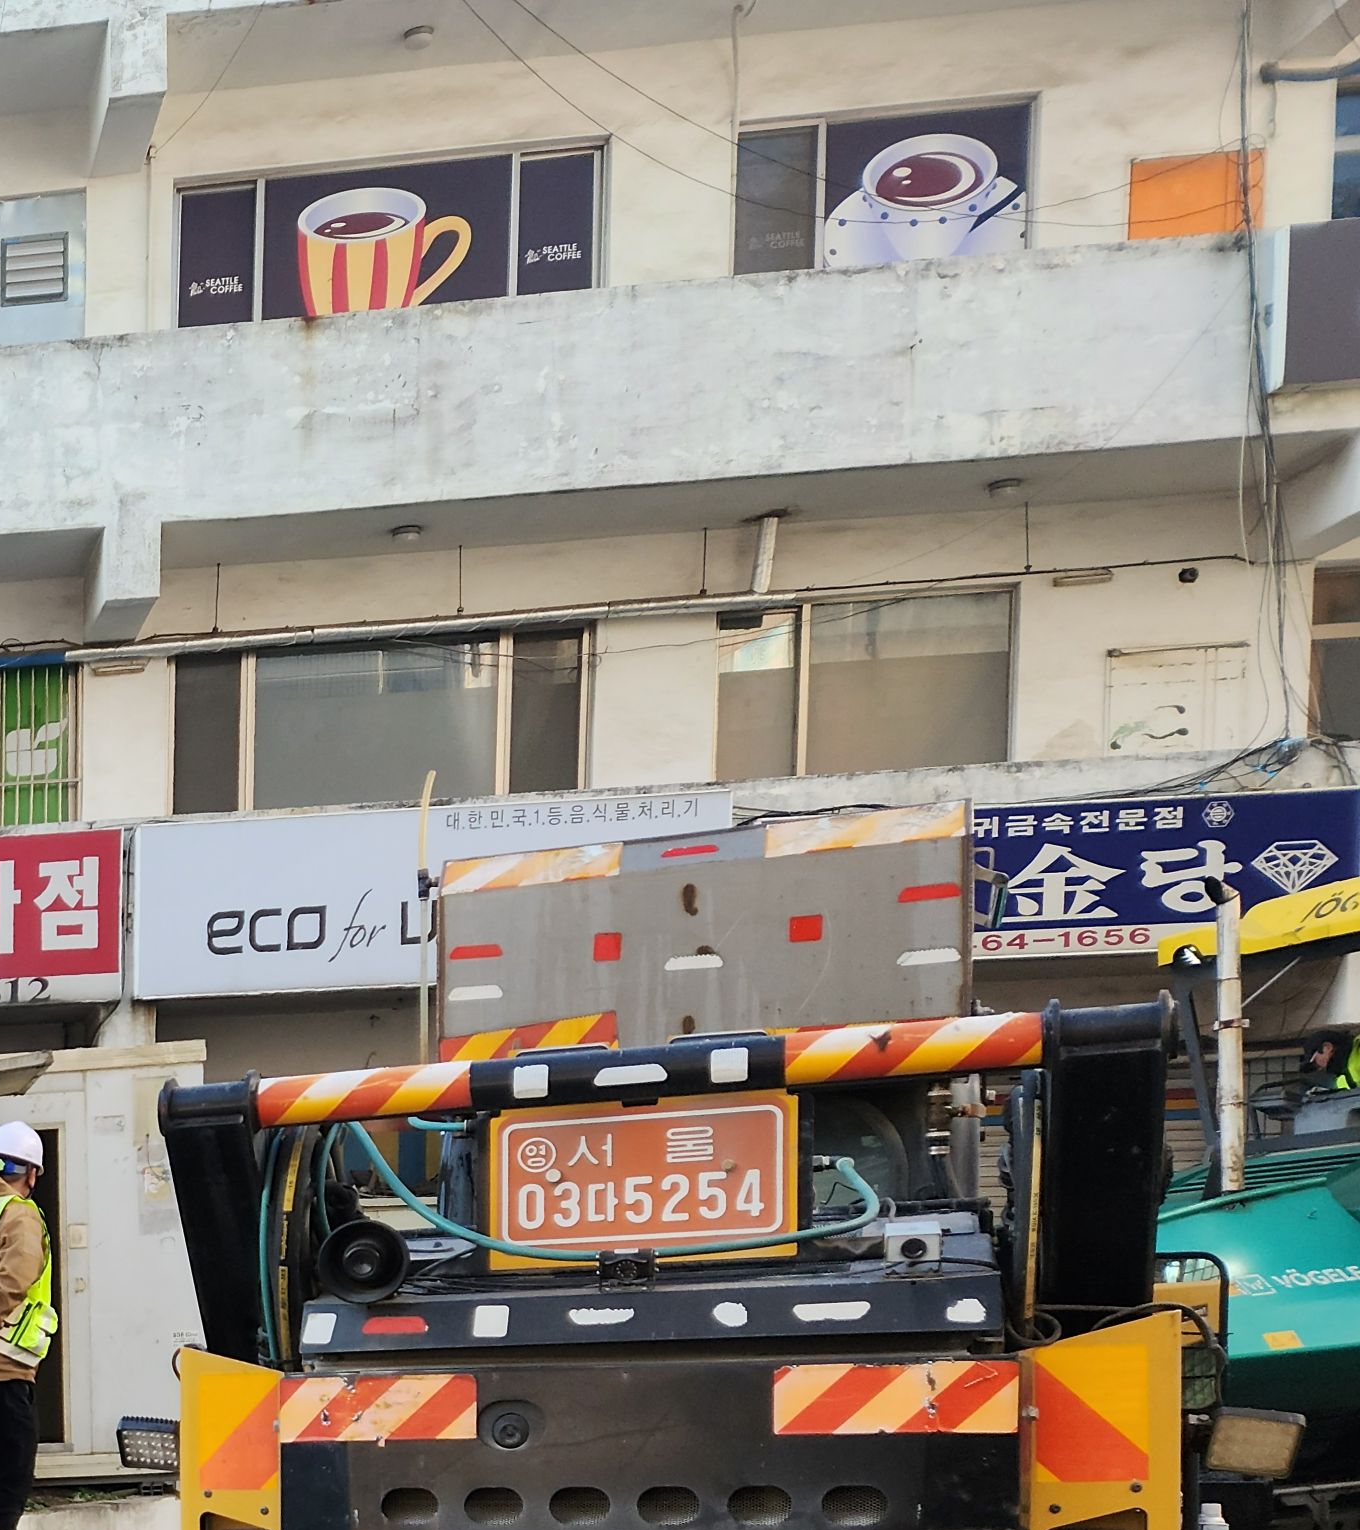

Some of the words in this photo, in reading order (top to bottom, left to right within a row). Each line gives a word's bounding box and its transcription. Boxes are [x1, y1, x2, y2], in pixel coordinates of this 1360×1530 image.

[543, 243, 577, 254] SEATTLE
[548, 251, 581, 261] COFFEE
[206, 276, 239, 287] SEATTLE
[210, 284, 243, 294] COFFEE
[974, 805, 1184, 838] 귀금속전문점
[207, 905, 327, 955] eco
[330, 889, 386, 963] for
[973, 927, 1151, 952] 64-1656
[518, 1168, 764, 1230] 03다5254
